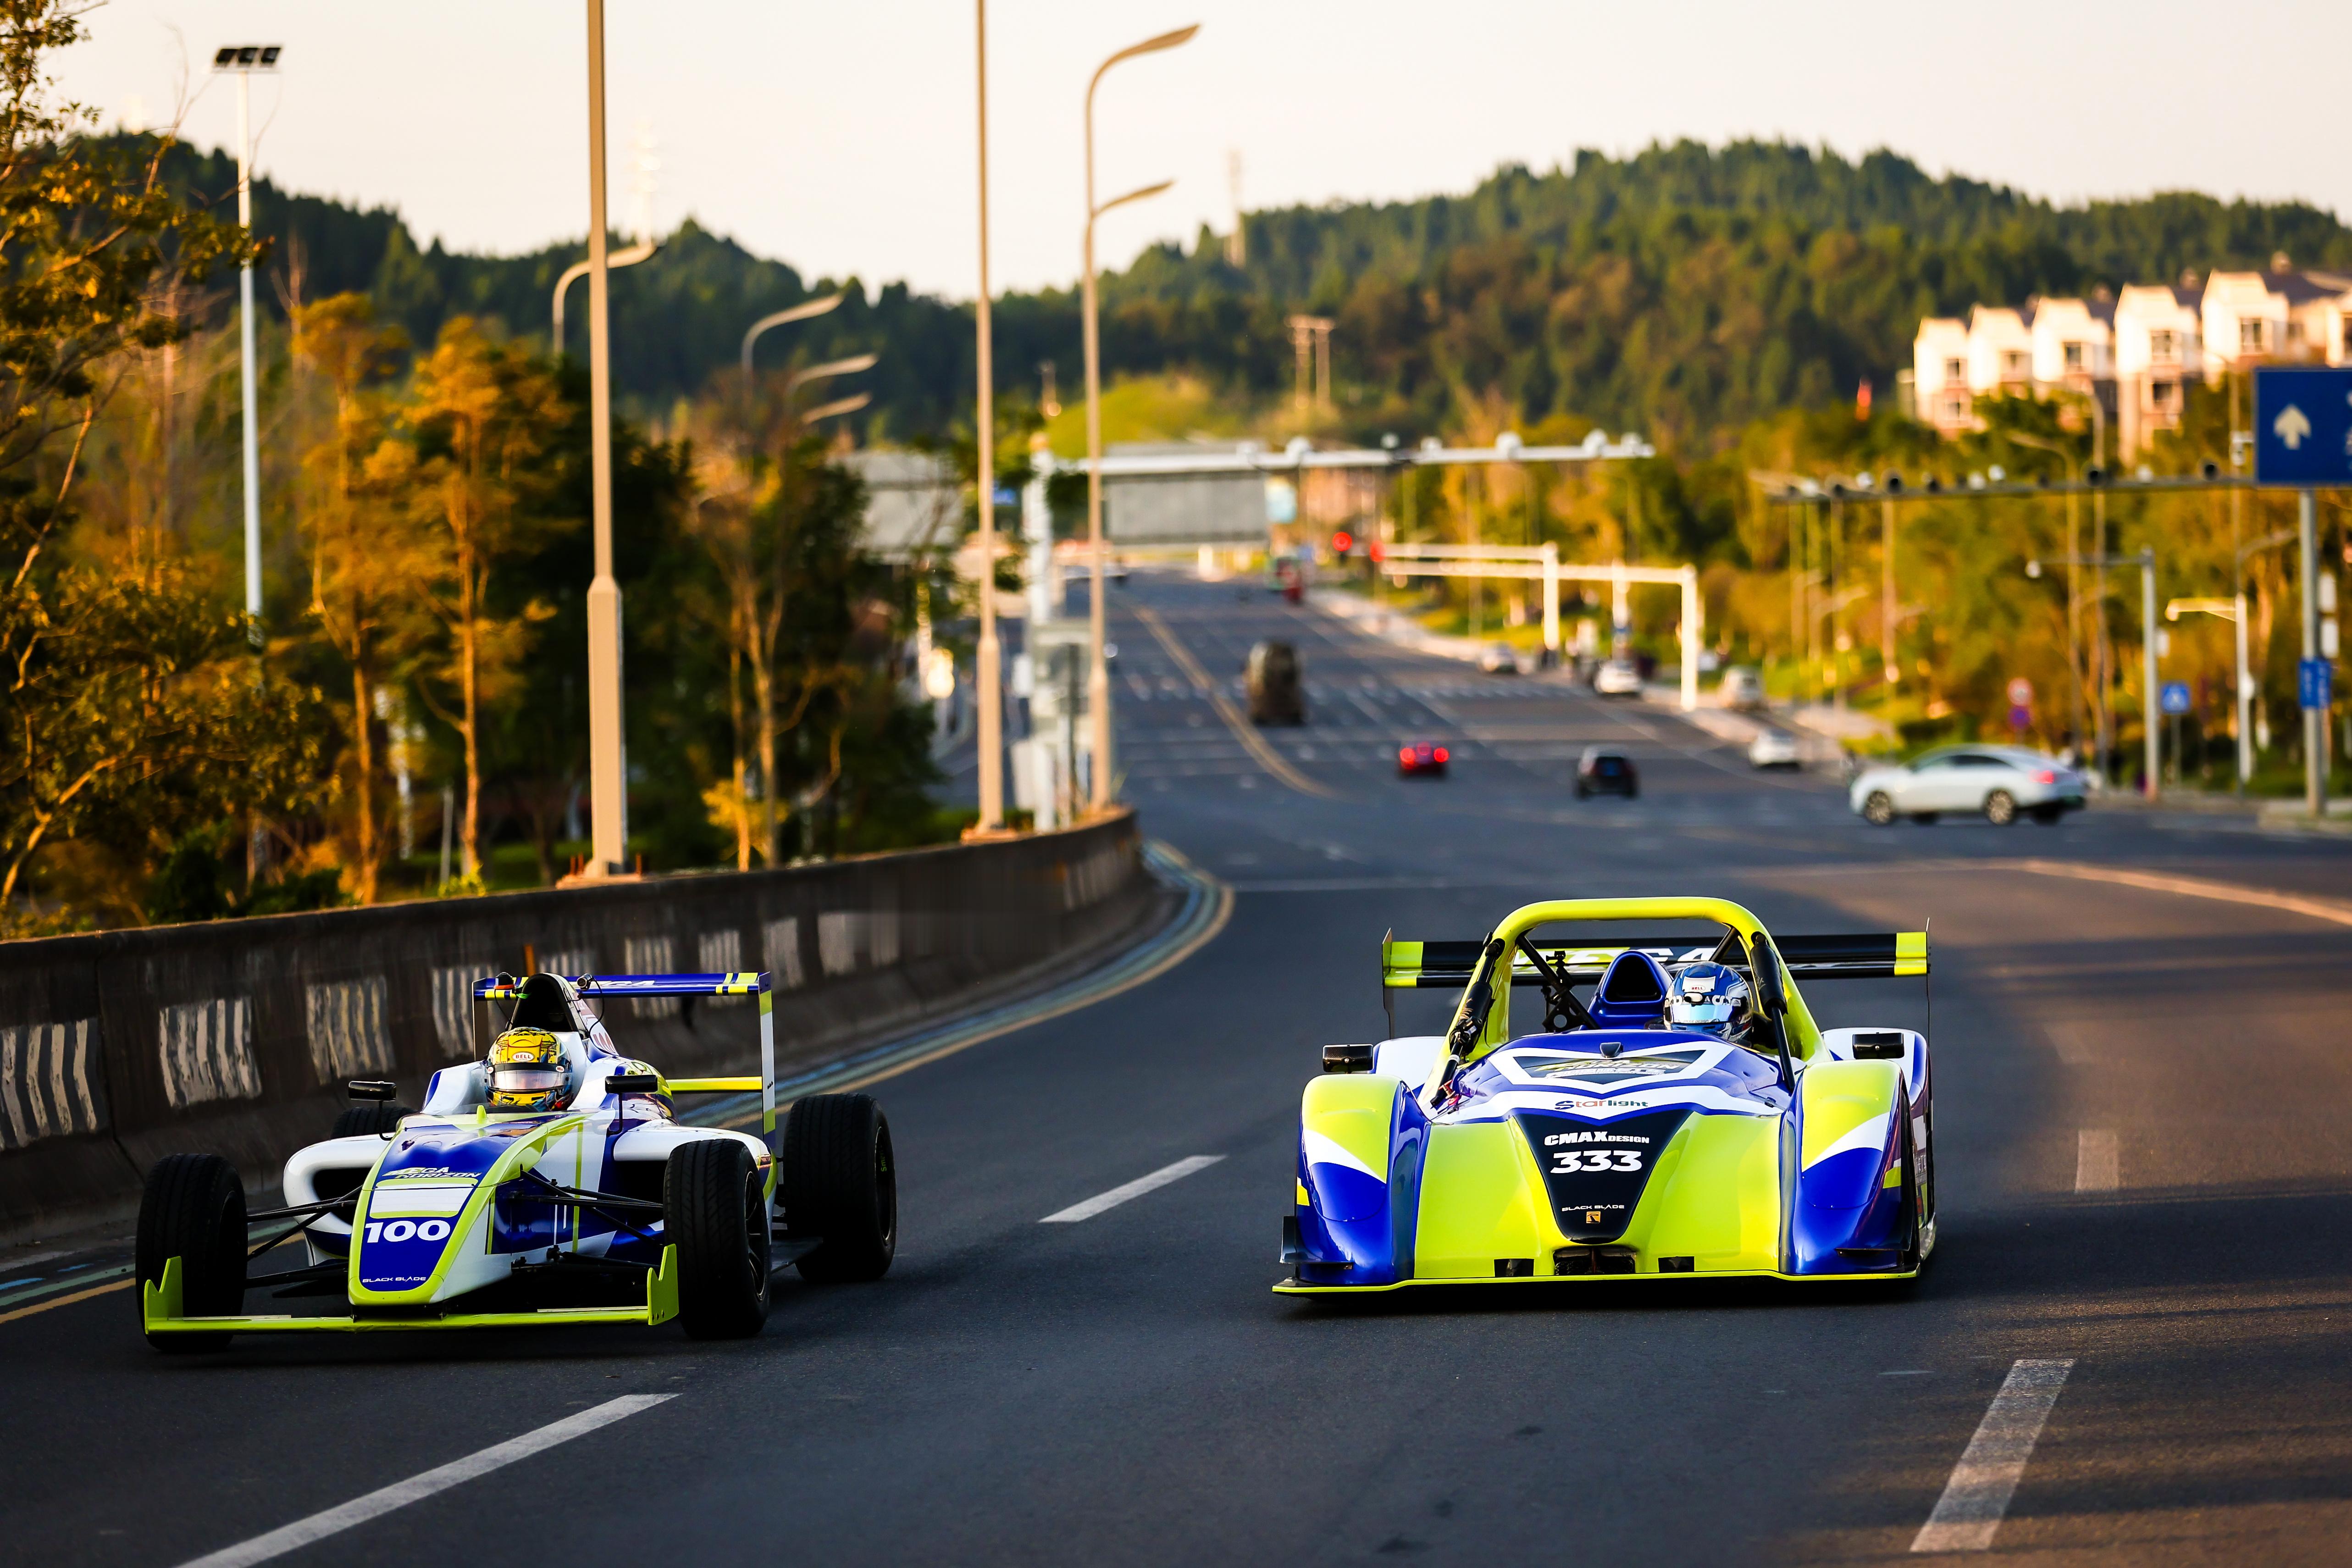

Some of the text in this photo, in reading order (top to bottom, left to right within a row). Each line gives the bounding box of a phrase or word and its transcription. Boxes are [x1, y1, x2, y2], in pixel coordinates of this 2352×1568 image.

[1555, 1100, 1648, 1110] Starlight
[1550, 1150, 1642, 1174] 333
[365, 1220, 450, 1243] 100
